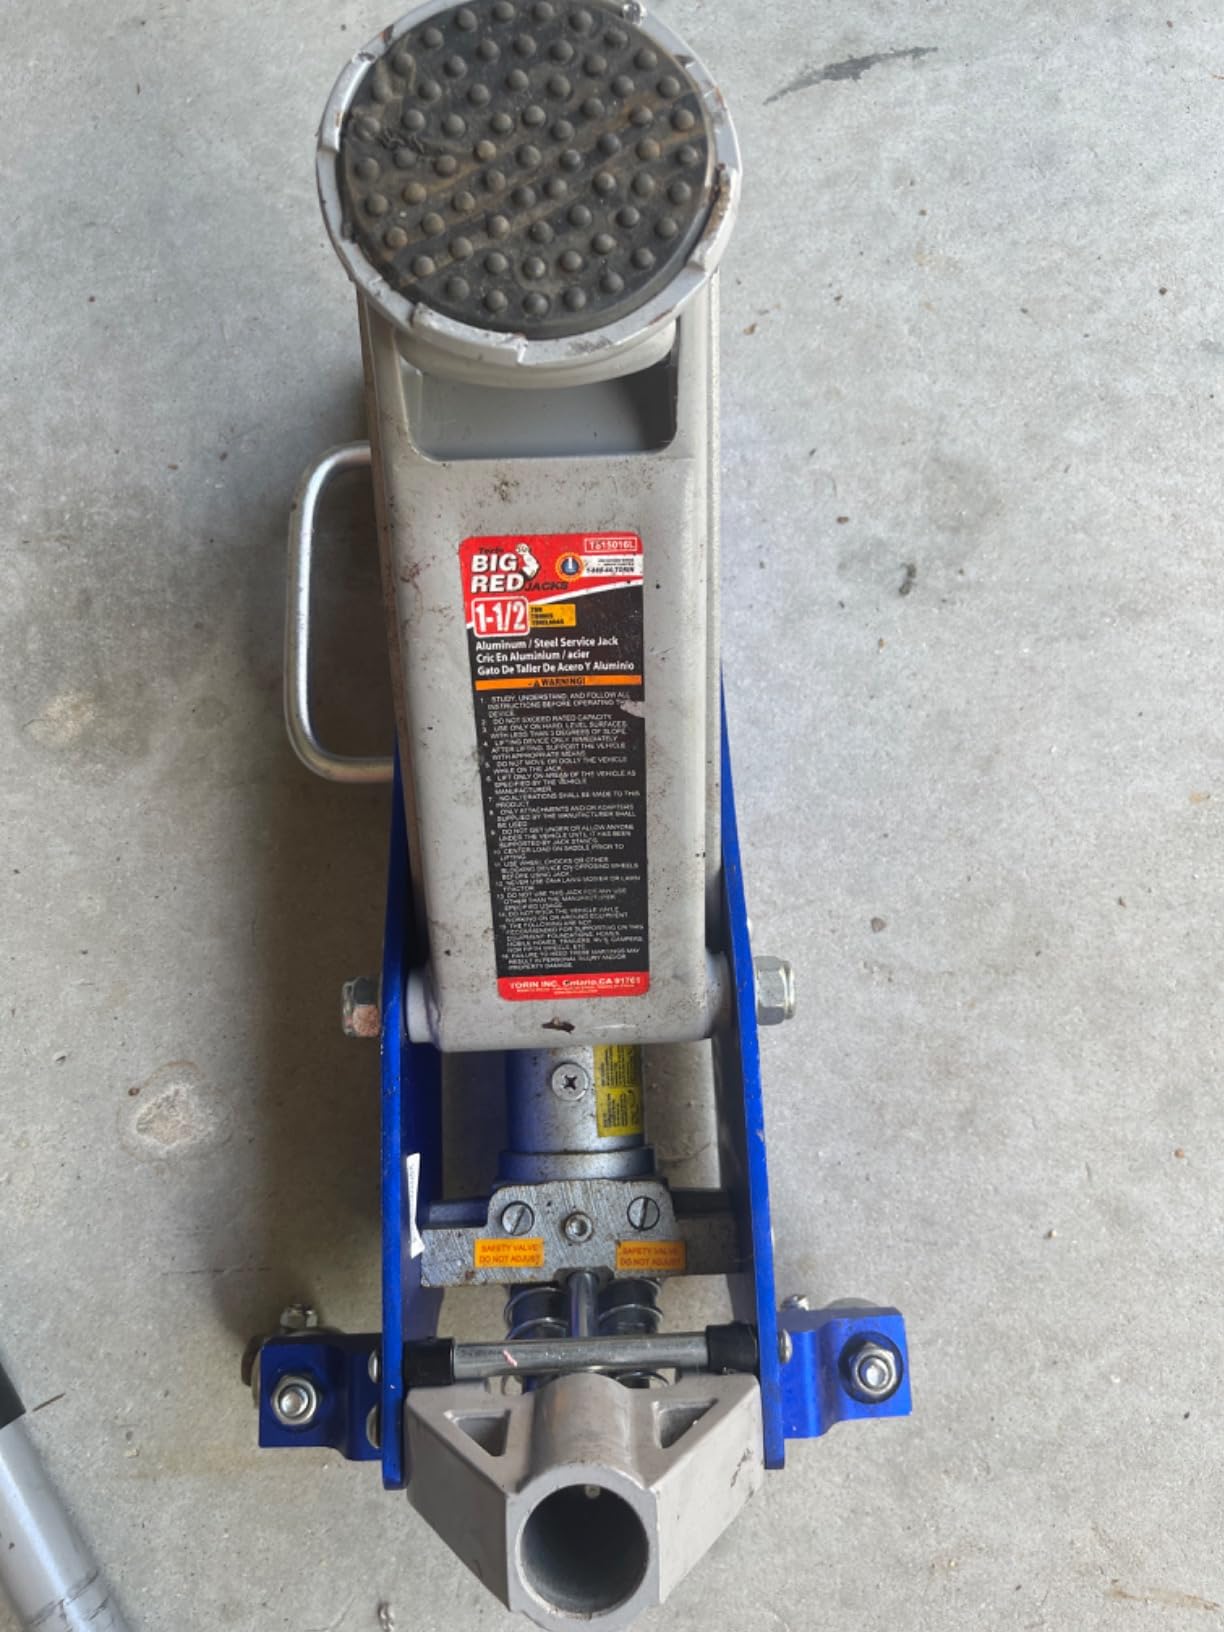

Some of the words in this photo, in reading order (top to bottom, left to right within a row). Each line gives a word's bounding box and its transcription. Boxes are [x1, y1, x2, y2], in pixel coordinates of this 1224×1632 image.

[471, 552, 518, 573] BIG
[470, 573, 525, 594] RED
[525, 582, 567, 592] JACKS
[475, 601, 526, 632] 1-1/2
[476, 640, 527, 651] Aluminum
[534, 637, 558, 649] Steel
[560, 636, 595, 647] Service
[598, 635, 618, 646] Jack
[476, 653, 494, 663] Cric
[496, 652, 508, 662] En
[510, 650, 561, 661] Aluminium
[567, 649, 590, 659] acier
[477, 665, 500, 676] Gato
[502, 664, 514, 675] De
[515, 662, 541, 673] Taller
[543, 662, 556, 673] De
[557, 661, 584, 672] Acero
[584, 661, 592, 671] Y
[593, 660, 635, 671] Aluminio
[541, 676, 586, 687] WARNING!
[510, 981, 539, 989] TORIN
[480, 1255, 491, 1264] DO
[493, 1255, 509, 1264] NOT
